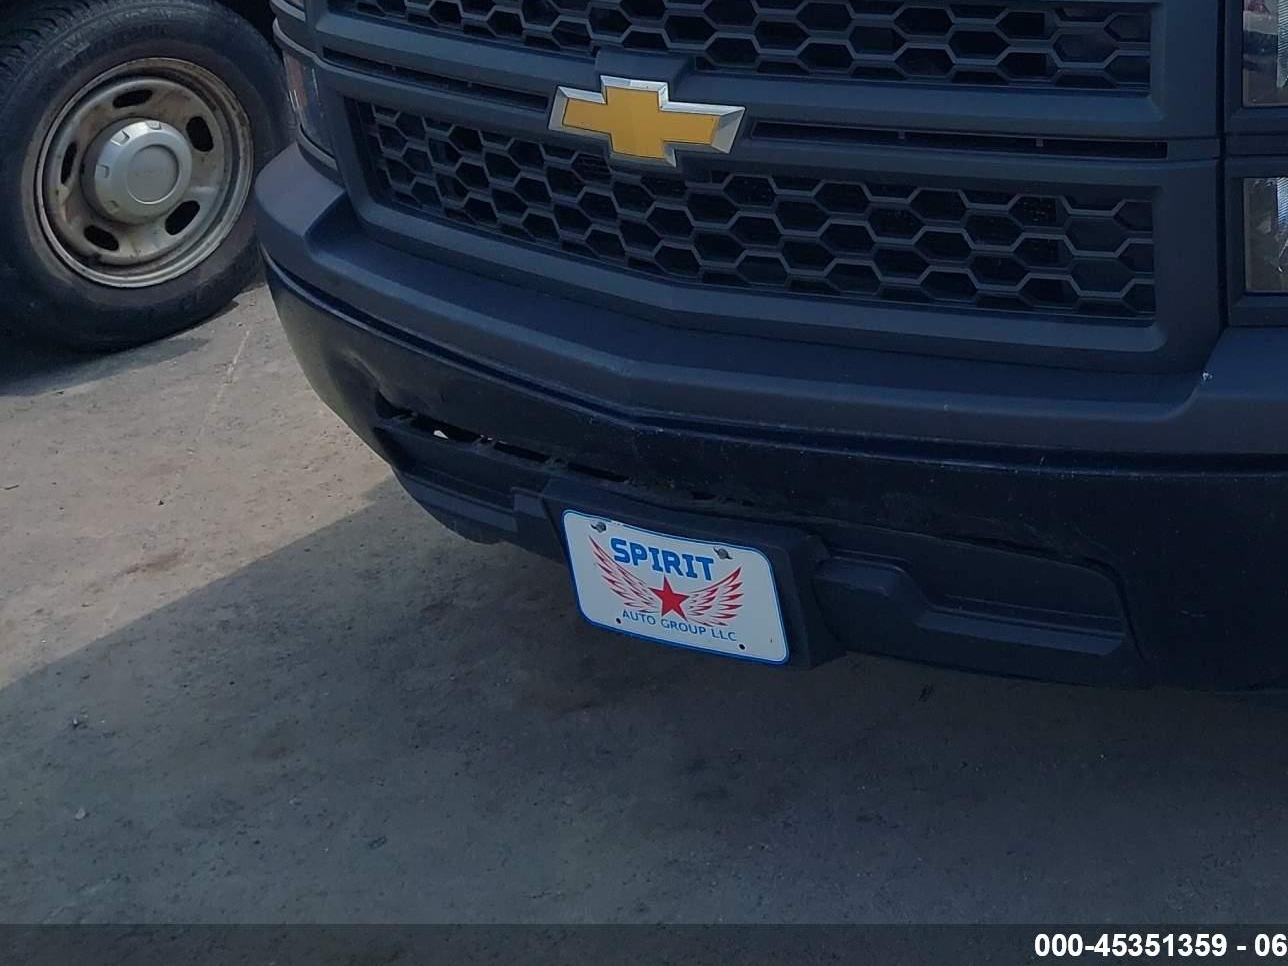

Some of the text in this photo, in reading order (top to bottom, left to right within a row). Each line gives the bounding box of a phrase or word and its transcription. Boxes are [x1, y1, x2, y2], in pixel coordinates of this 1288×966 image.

[610, 536, 714, 581] SPIRIT
[622, 609, 737, 642] AUTO GROUP LLC
